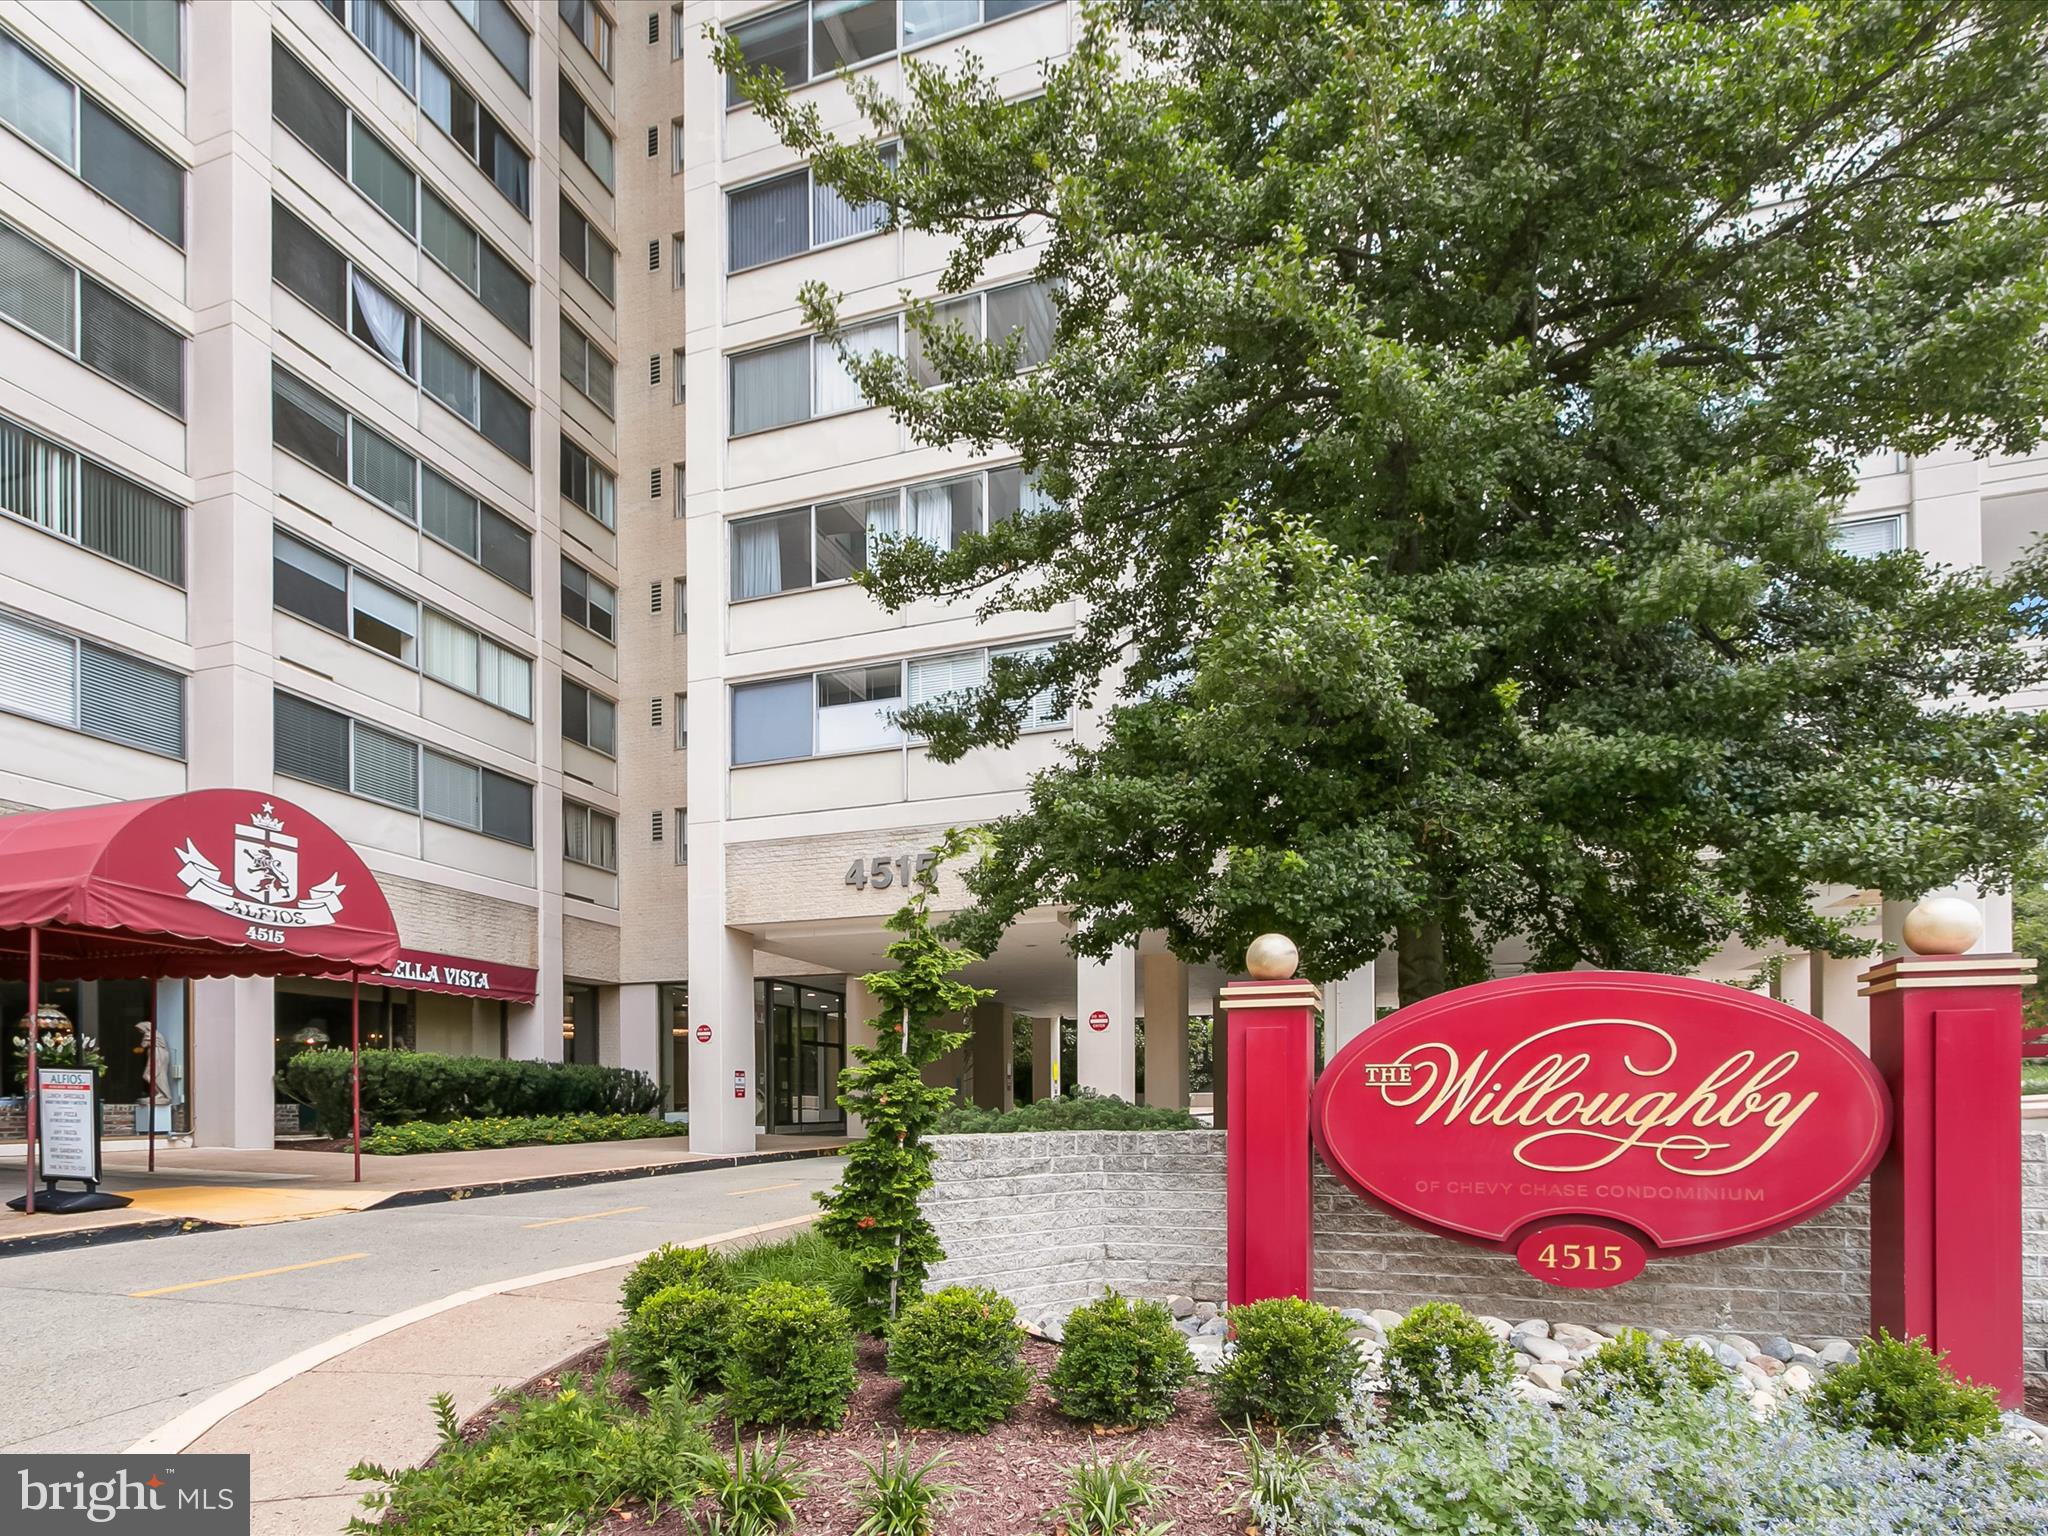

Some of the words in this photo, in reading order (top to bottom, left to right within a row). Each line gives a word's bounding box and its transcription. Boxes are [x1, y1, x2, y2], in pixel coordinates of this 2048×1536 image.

[225, 901, 306, 925] ALFIOS
[246, 926, 285, 944] 4515
[381, 960, 440, 983] ELLA
[443, 967, 490, 989] VISTA
[51, 1074, 83, 1084] ALFIOS
[1365, 1067, 1412, 1082] THE
[1381, 1019, 1819, 1176] Willoughby
[1415, 1181, 1440, 1193] OF
[1447, 1181, 1513, 1195] CHEVY
[1519, 1183, 1588, 1197] CHASE
[1596, 1184, 1765, 1202] CONDOMINIUM
[1538, 1244, 1622, 1272] 4515
